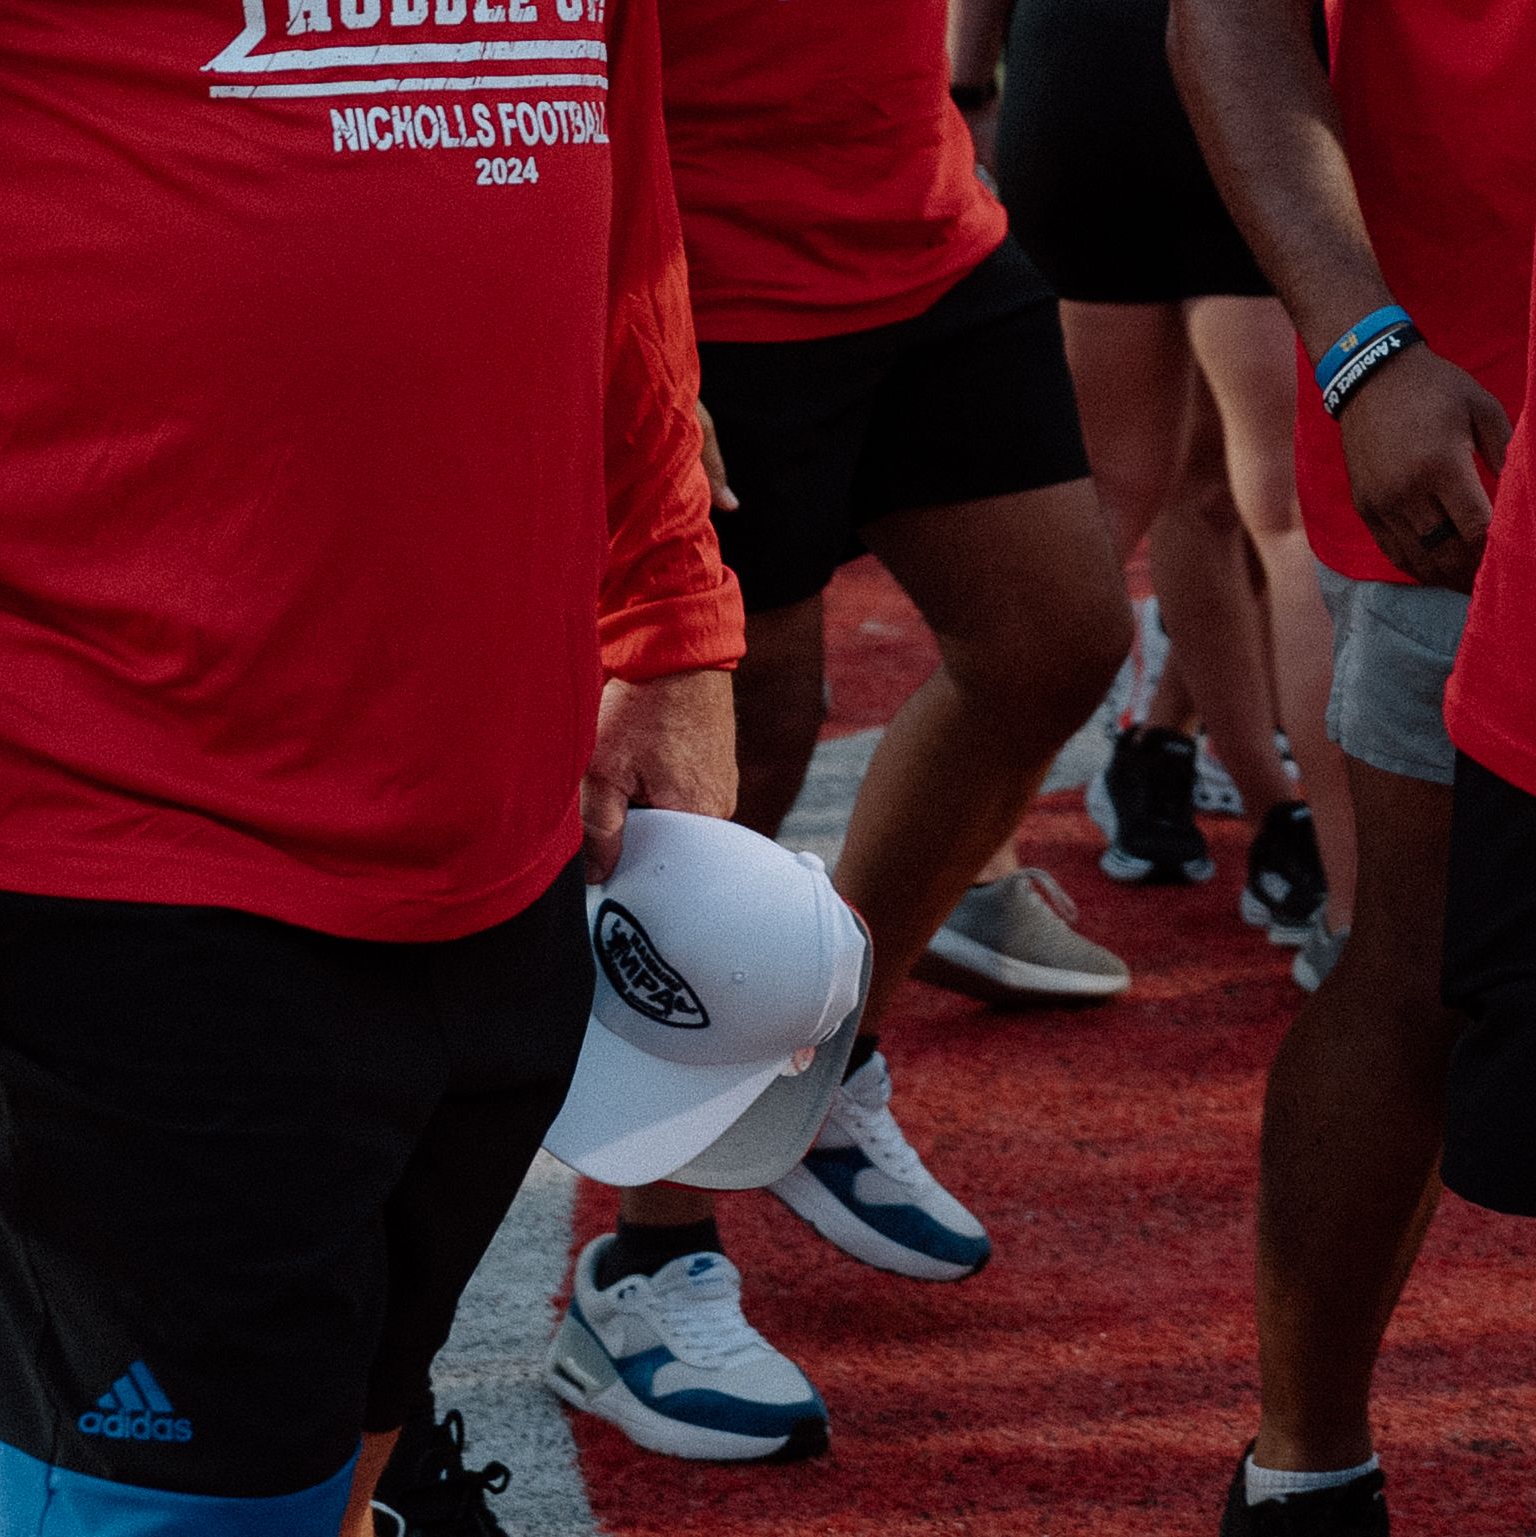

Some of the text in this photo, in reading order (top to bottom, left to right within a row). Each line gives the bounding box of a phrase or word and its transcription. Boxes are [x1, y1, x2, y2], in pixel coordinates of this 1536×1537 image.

[330, 99, 610, 153] NICHOLLS FOOTBALL
[475, 156, 539, 186] 2024
[1337, 340, 1389, 395] AUDIENCE
[78, 1409, 193, 1443] adidas
